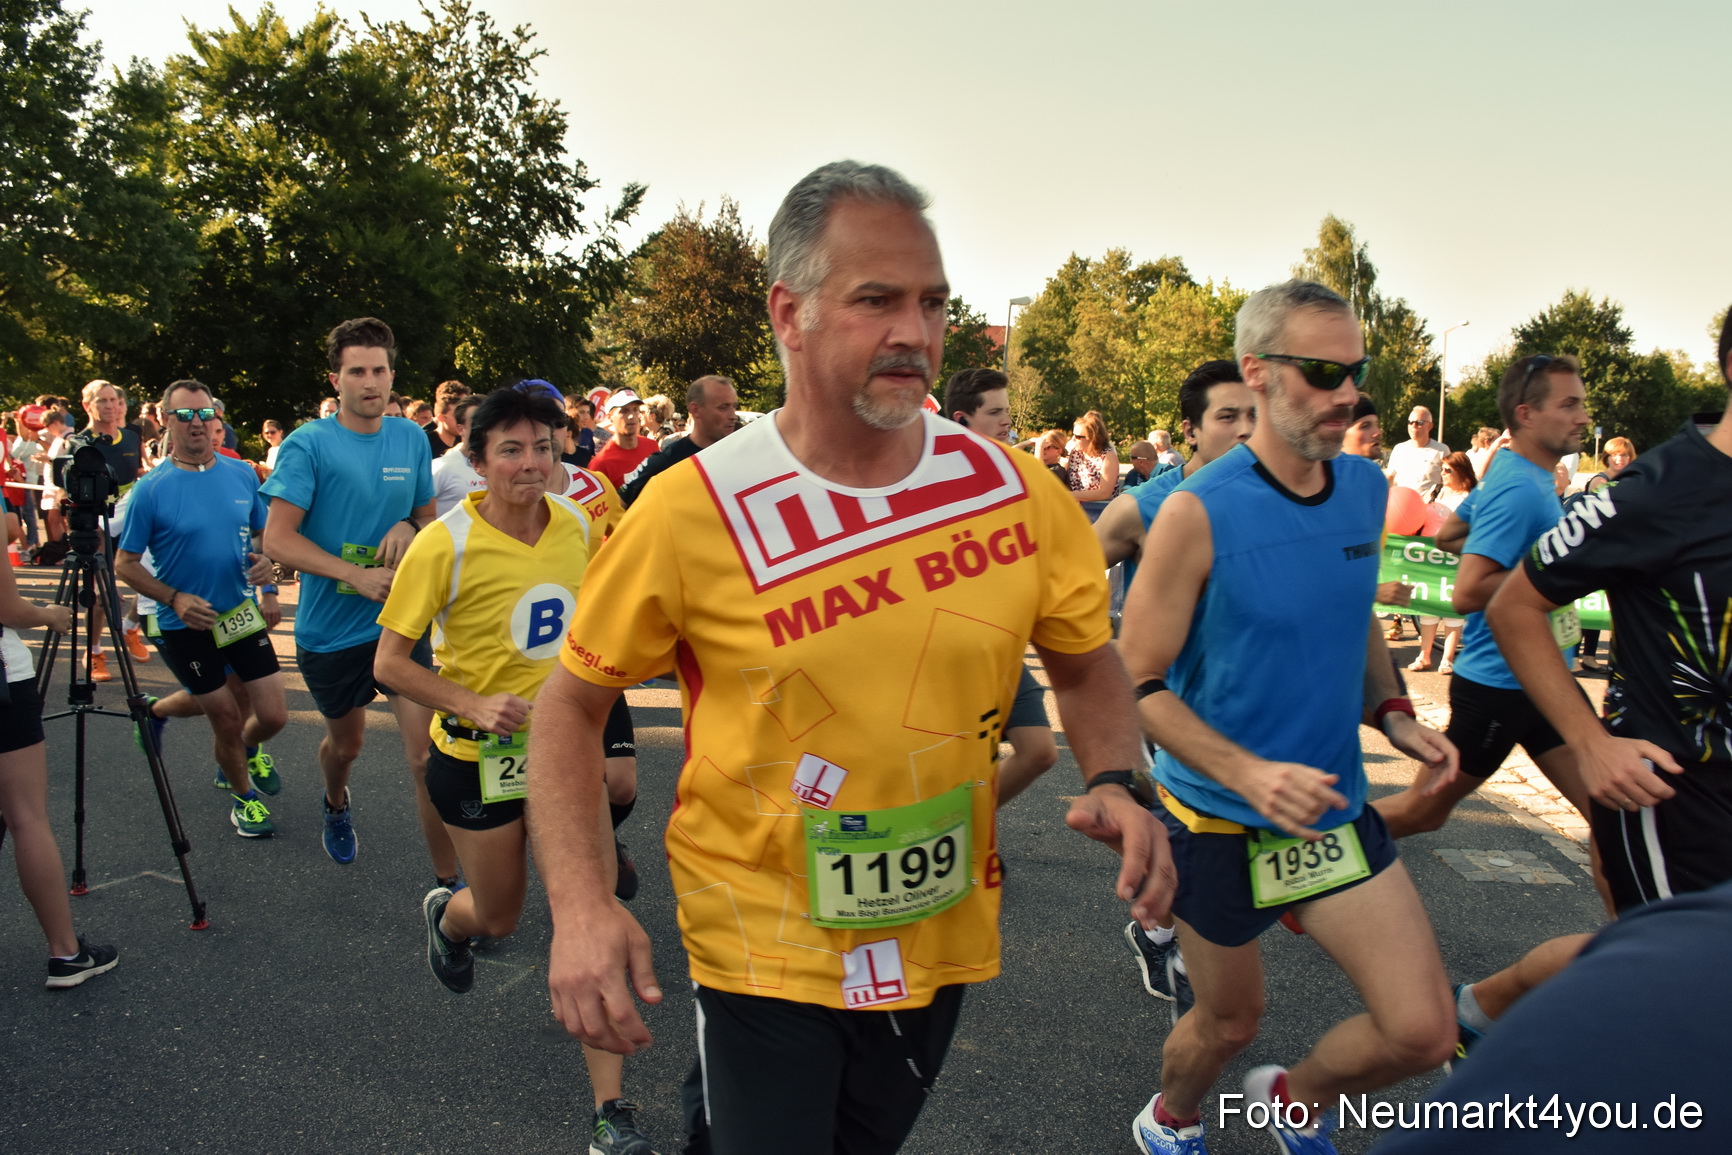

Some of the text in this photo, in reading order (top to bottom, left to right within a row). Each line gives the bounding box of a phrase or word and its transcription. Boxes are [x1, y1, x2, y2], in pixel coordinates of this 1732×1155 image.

[763, 521, 1039, 648] MAX BÖGL
[218, 607, 255, 636] 1395
[526, 597, 565, 650] B
[830, 835, 957, 895] 1199
[1266, 832, 1344, 881] 1938
[836, 909, 857, 918] Max
[858, 908, 881, 918] Bögl
[857, 885, 941, 908] Hetzel Oliver
